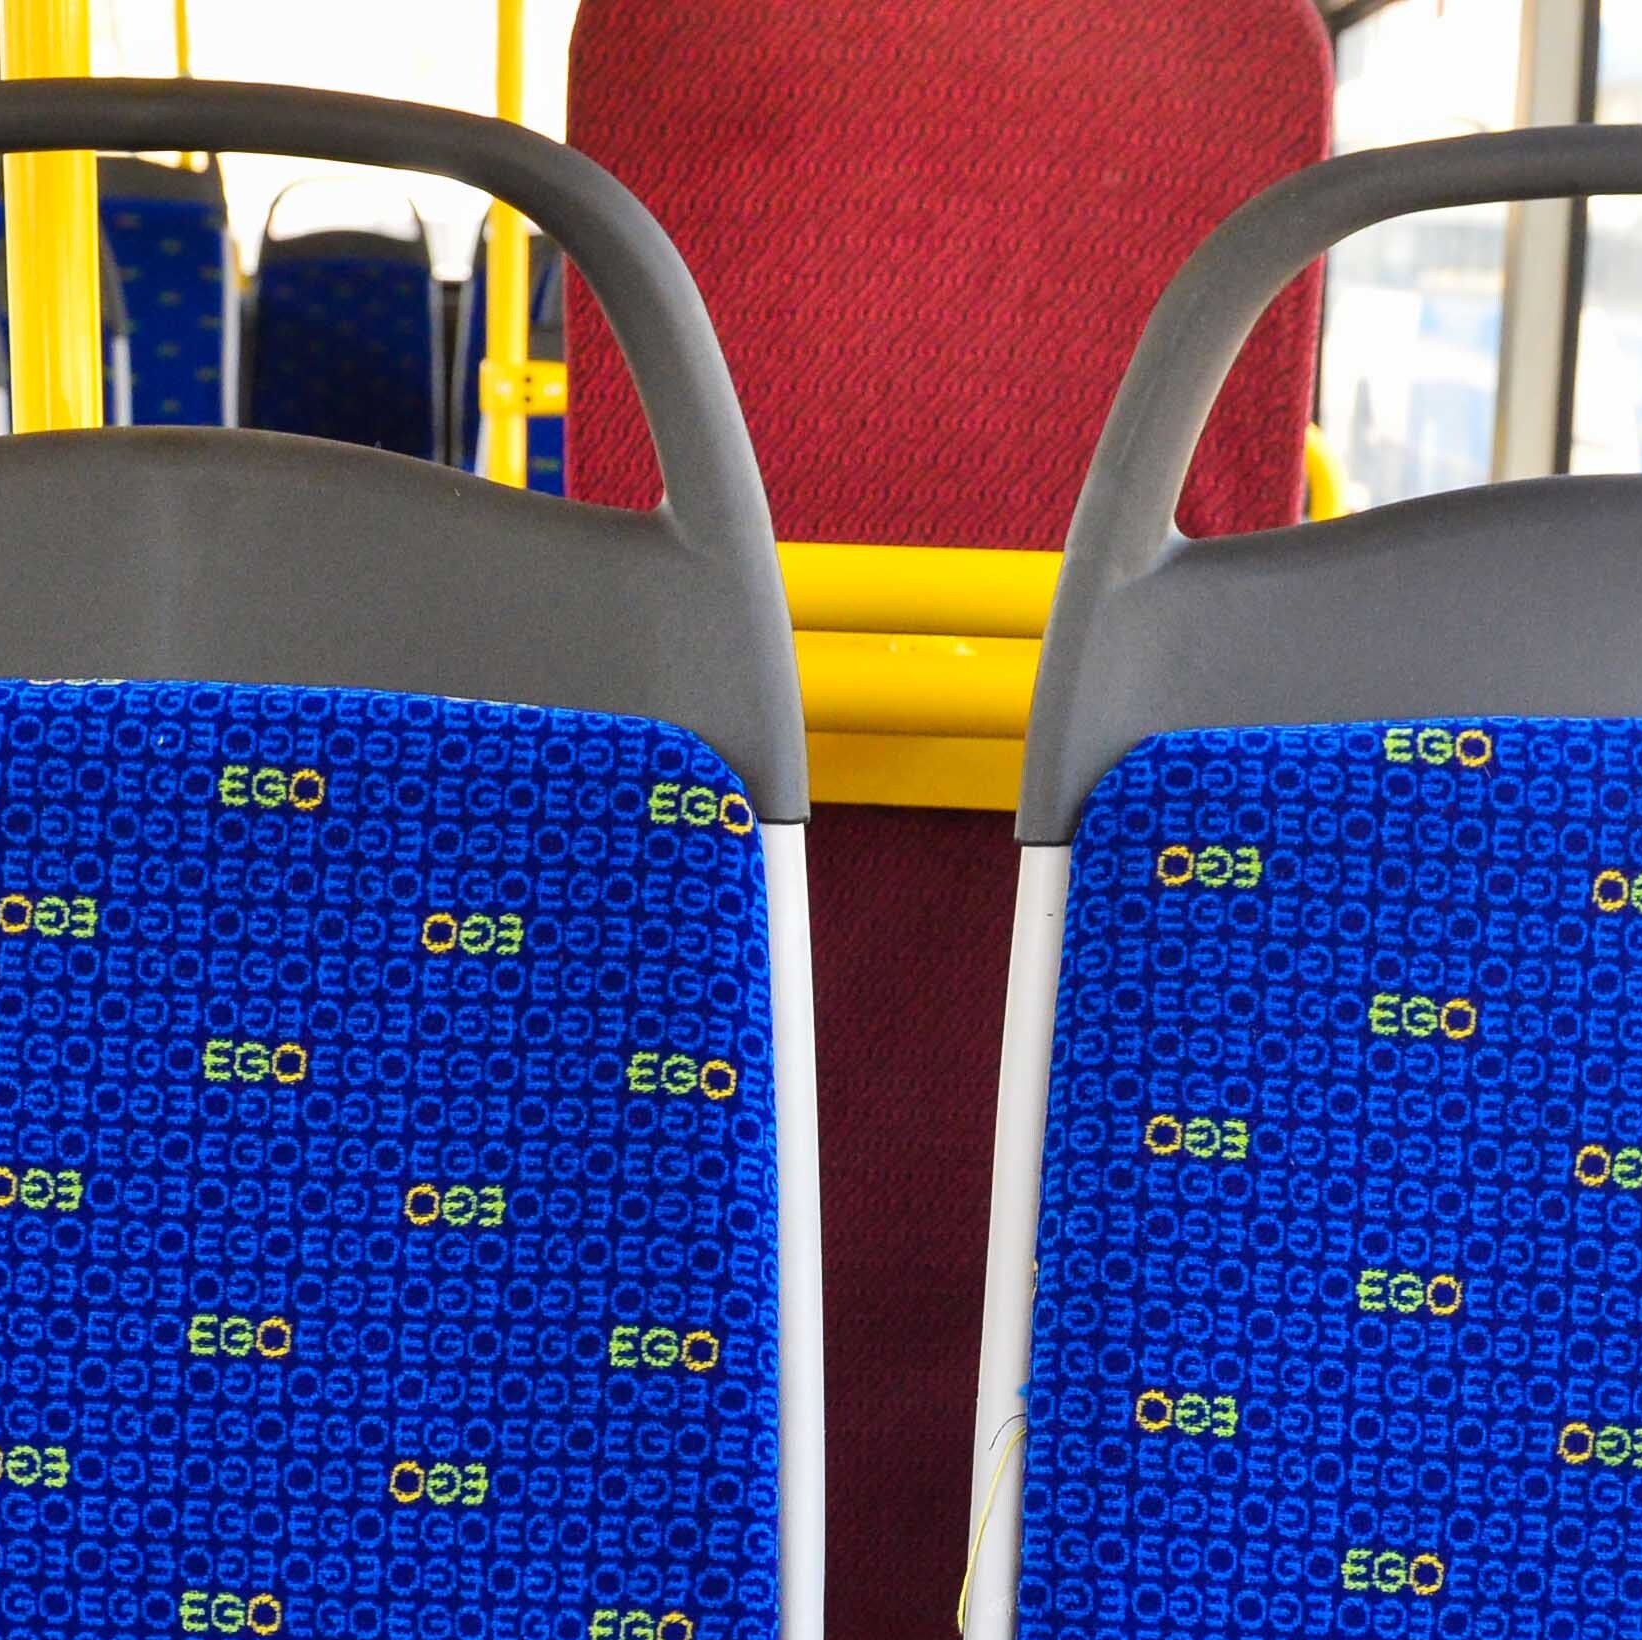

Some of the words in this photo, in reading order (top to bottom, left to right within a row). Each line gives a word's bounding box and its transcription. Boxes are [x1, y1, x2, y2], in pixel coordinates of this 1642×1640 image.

[1385, 729, 1491, 766] EGO
[219, 766, 324, 810] EGO
[649, 784, 752, 834] EGO
[1369, 994, 1476, 1039] EGO
[204, 1040, 306, 1083] EGO
[627, 1052, 736, 1099] EGO
[1357, 1270, 1461, 1315] EGO
[188, 1315, 291, 1357] EGO
[610, 1326, 718, 1371] EGO
[1342, 1550, 1444, 1594] EGO
[181, 1592, 281, 1635] EGO
